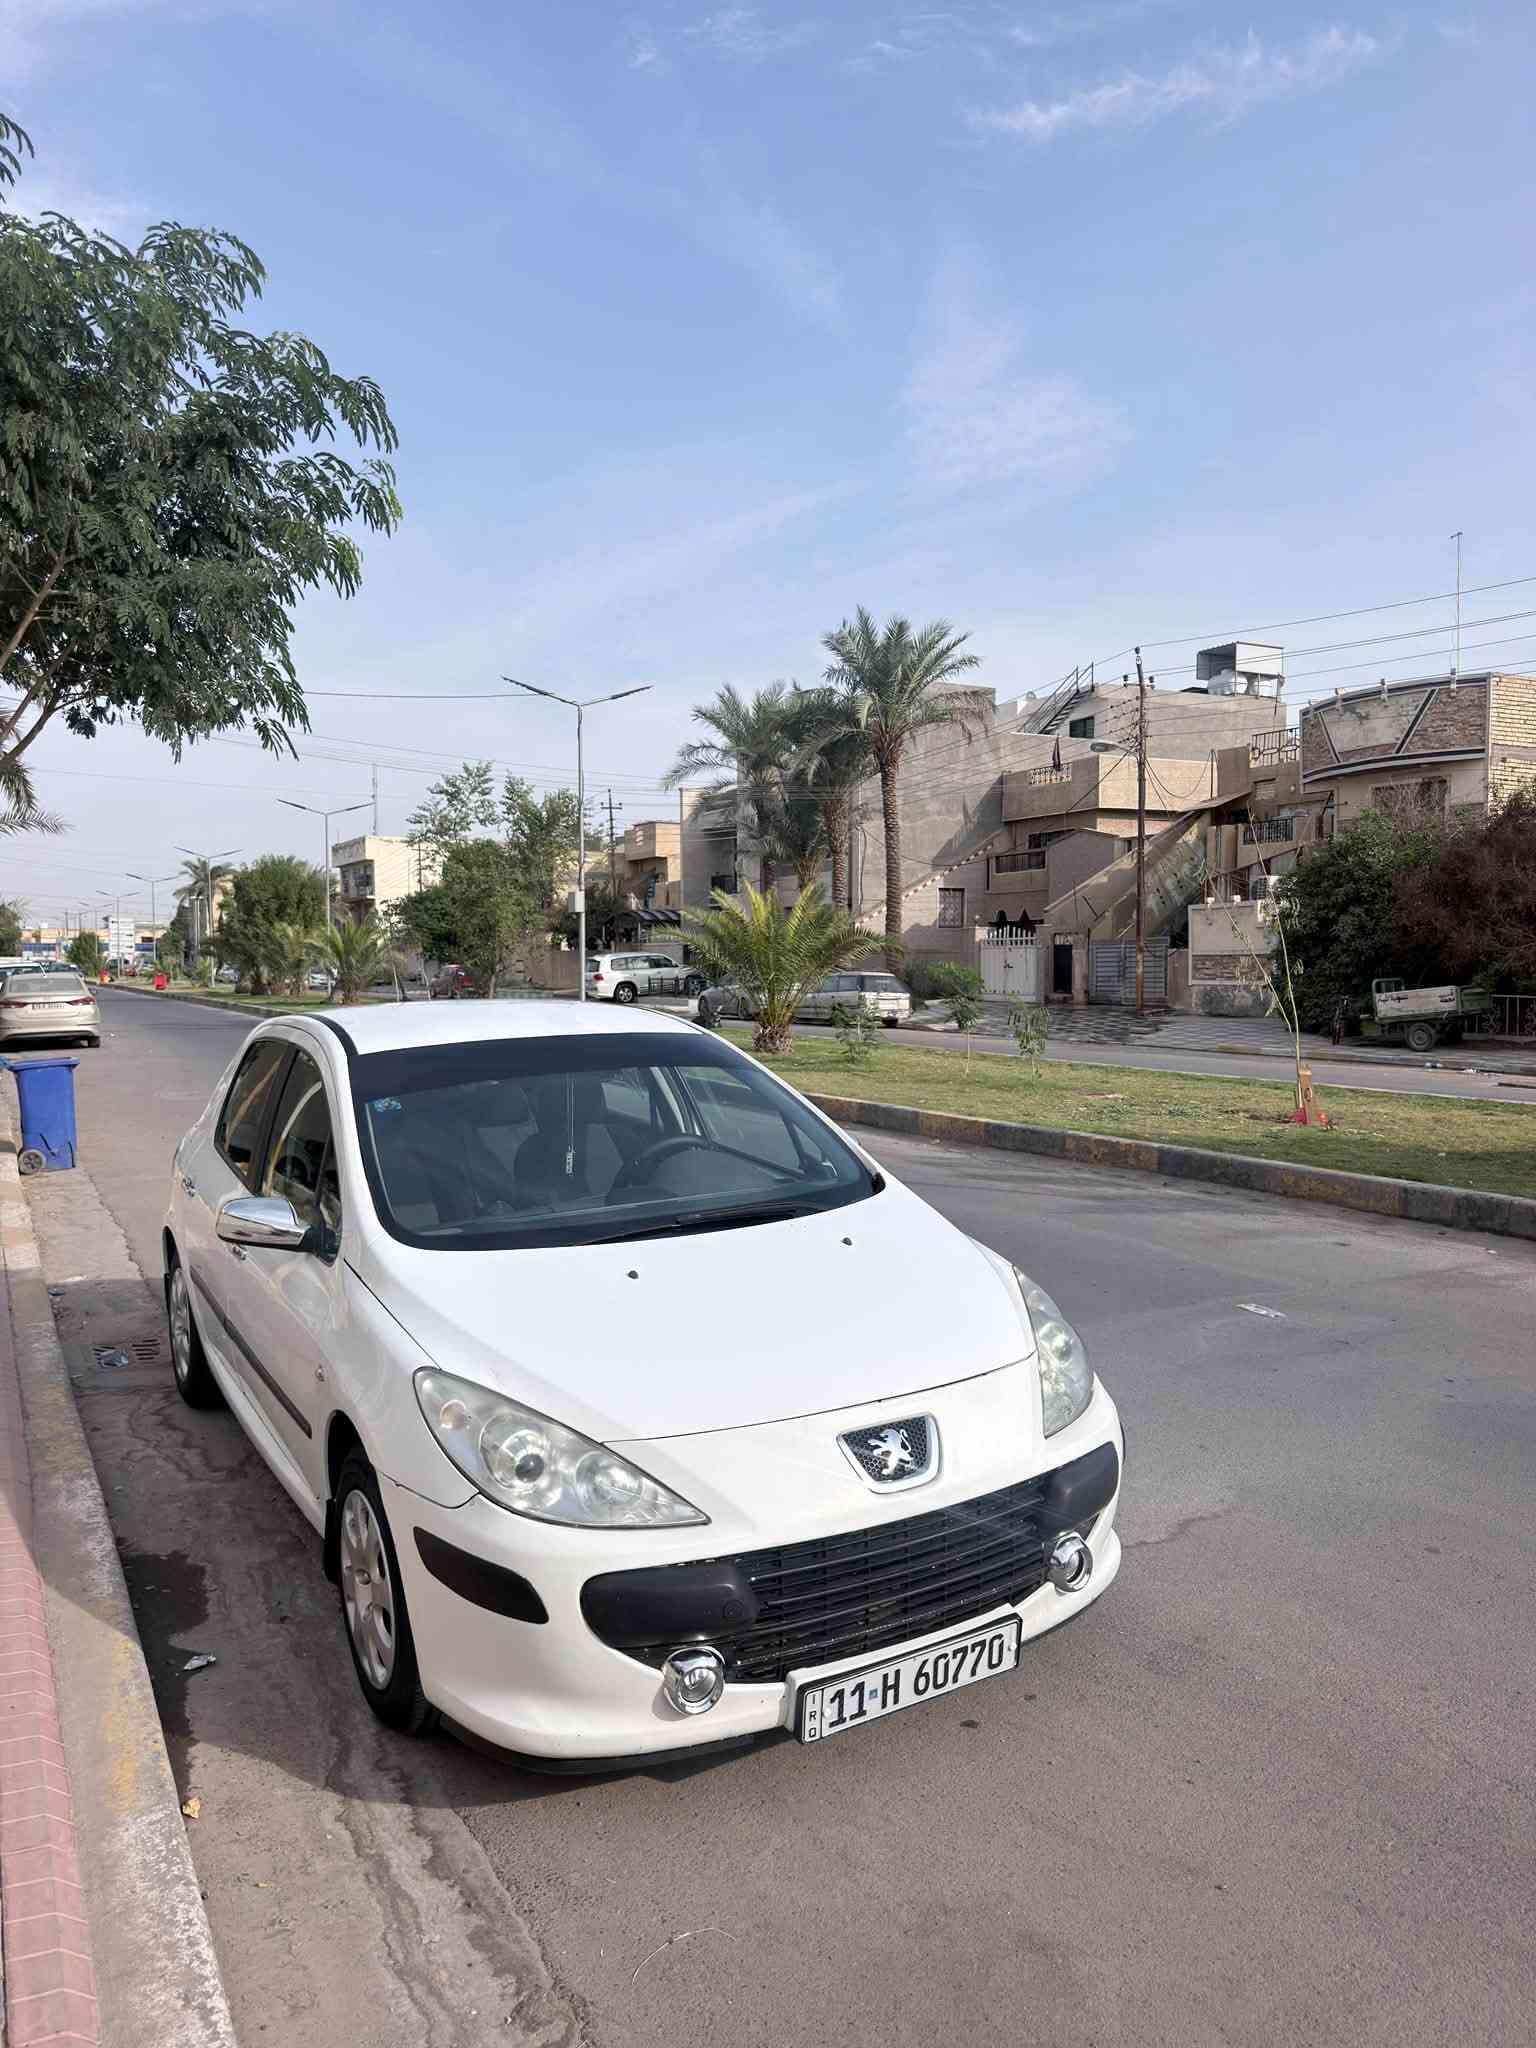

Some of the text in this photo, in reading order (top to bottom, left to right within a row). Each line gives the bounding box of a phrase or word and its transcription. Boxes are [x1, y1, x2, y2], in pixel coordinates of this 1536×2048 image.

[828, 1633, 1004, 1728] 11 H 60770
